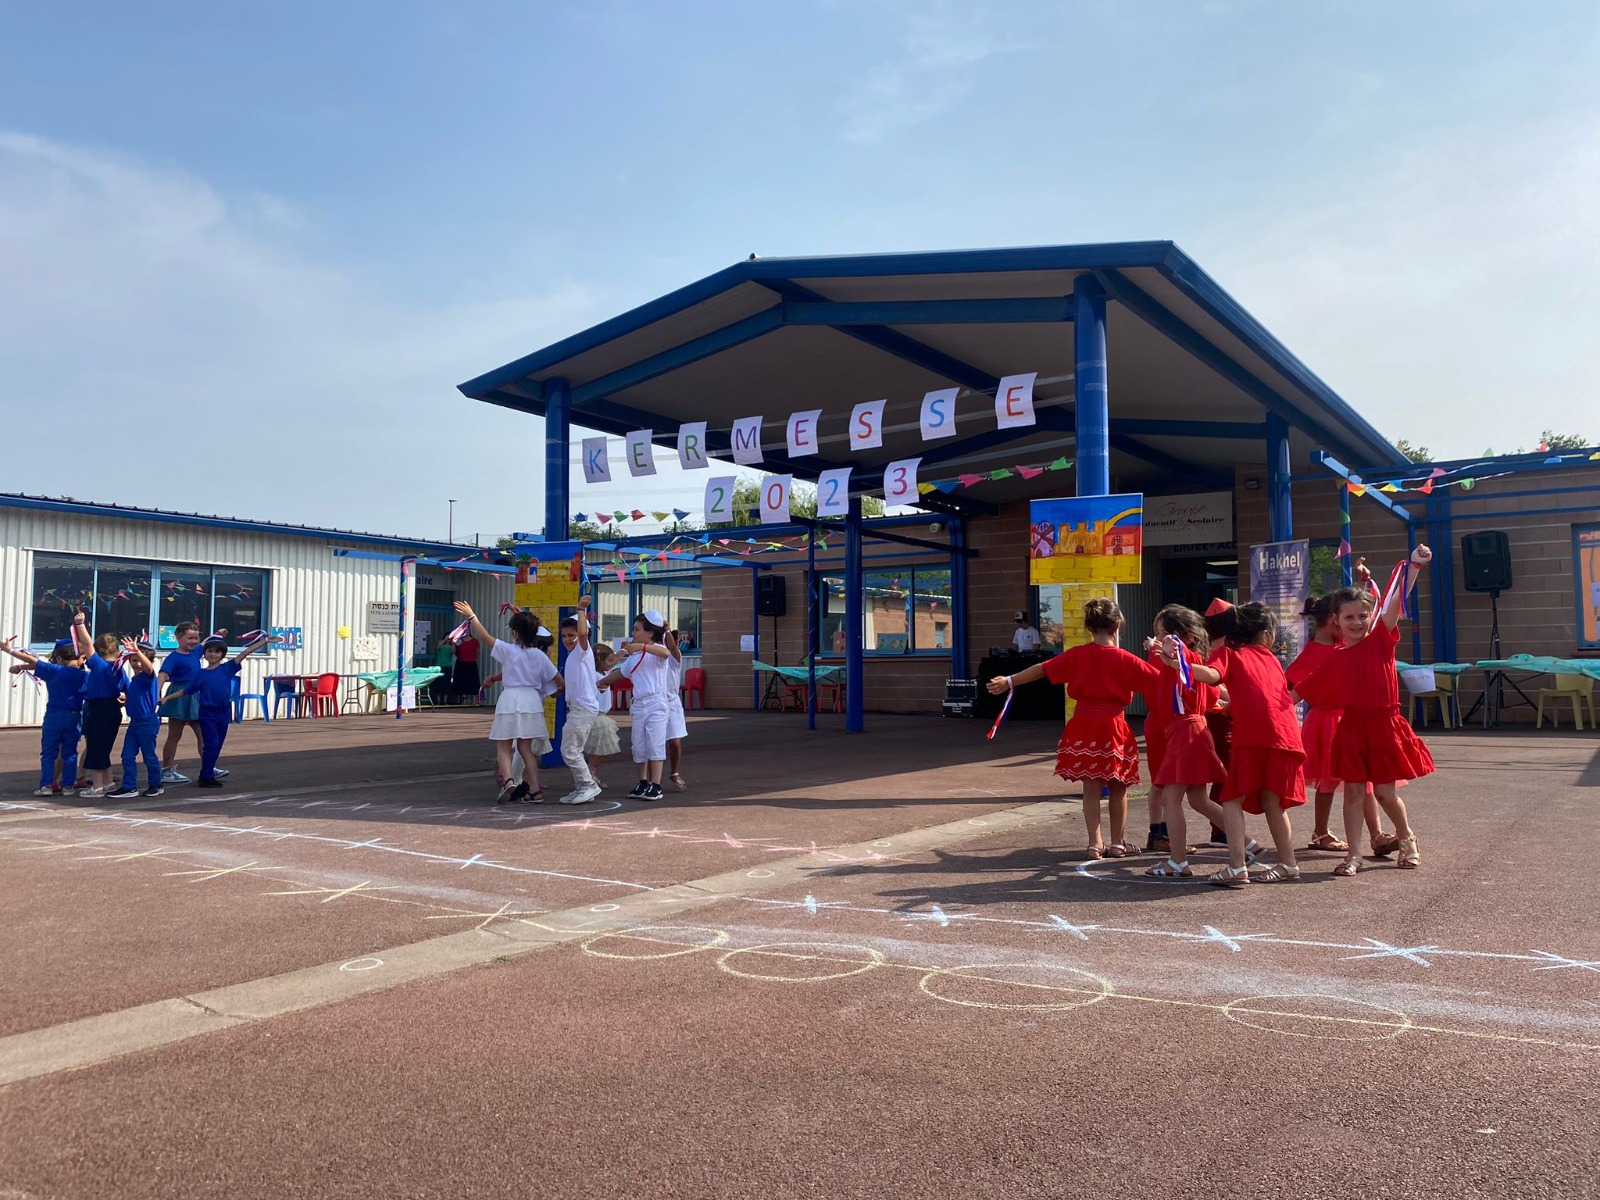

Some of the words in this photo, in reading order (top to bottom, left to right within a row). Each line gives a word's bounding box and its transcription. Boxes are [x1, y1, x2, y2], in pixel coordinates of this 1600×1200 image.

[588, 385, 1024, 475] KERMESSE
[710, 466, 908, 513] 2023
[1145, 519, 1176, 527] ducatif
[1259, 550, 1300, 571] Hakhel
